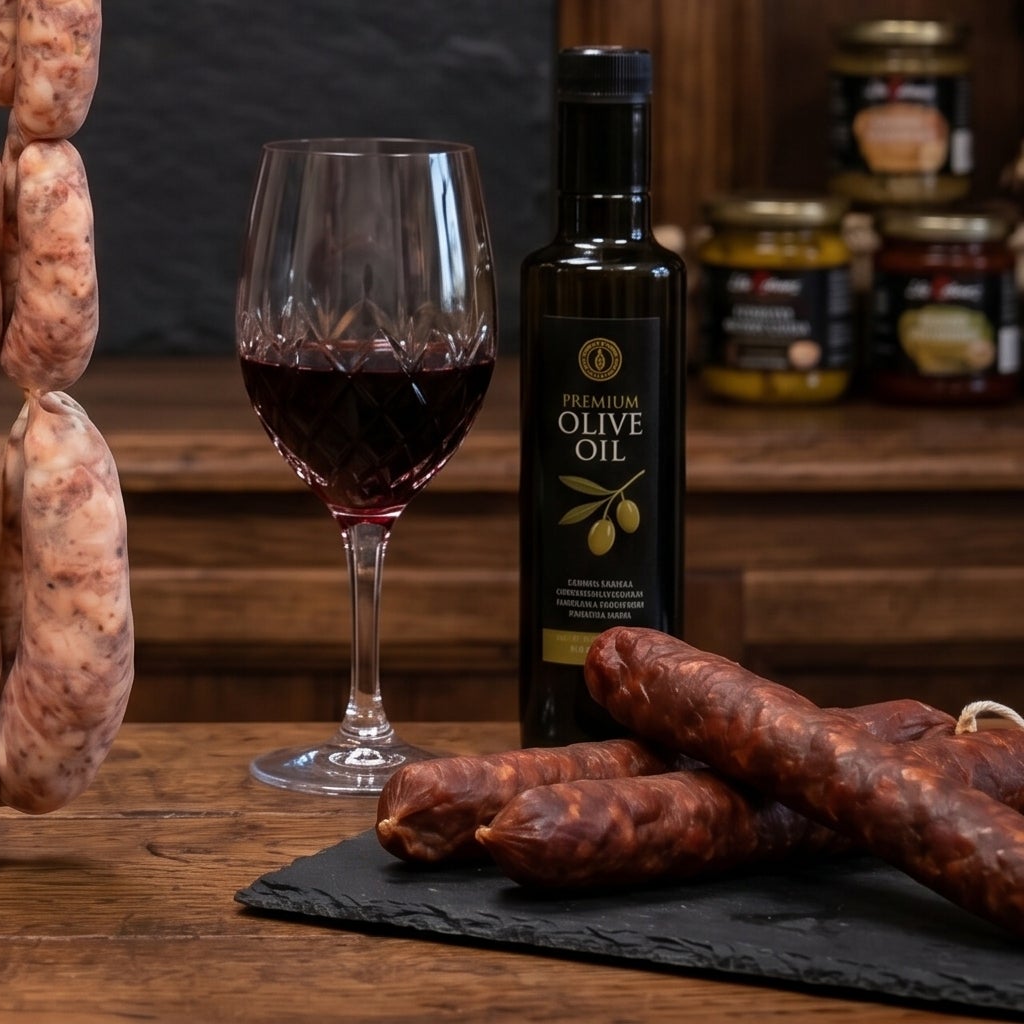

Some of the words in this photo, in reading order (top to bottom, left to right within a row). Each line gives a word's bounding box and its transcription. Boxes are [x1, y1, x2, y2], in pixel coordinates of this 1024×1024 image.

[562, 393, 639, 409] PREMIUM
[558, 411, 643, 436] OLIVE
[575, 438, 626, 462] OIL
